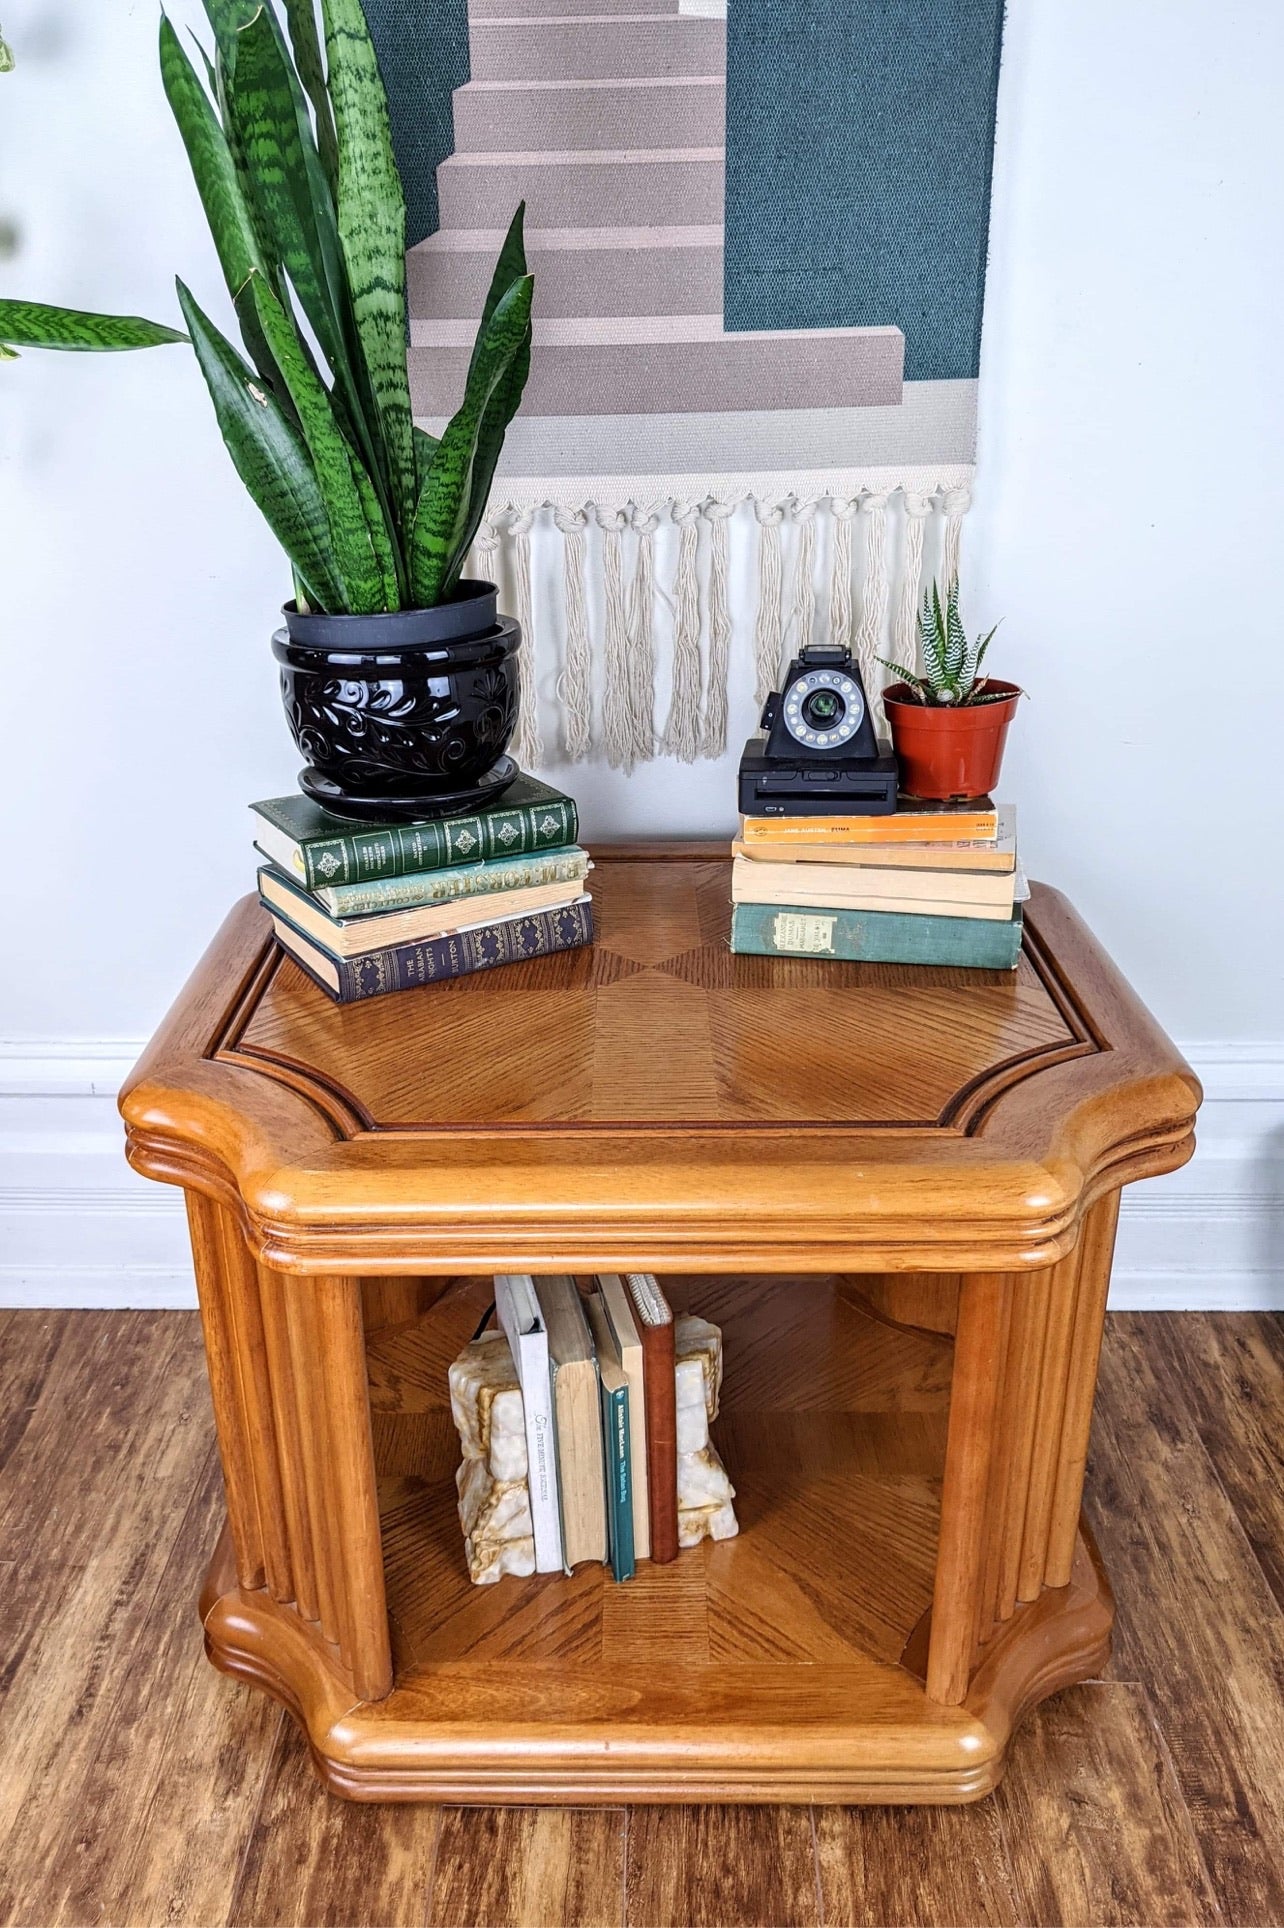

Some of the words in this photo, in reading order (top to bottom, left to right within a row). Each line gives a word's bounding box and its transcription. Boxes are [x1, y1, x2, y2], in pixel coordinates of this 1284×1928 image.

[431, 868, 531, 898] FORSTER
[352, 897, 410, 912] COLLECTED
[787, 920, 795, 945] DUMAS
[406, 959, 415, 977] THE
[415, 947, 425, 982] ARABIAN
[425, 947, 436, 978] NIGHTS
[448, 940, 459, 973] BURTON
